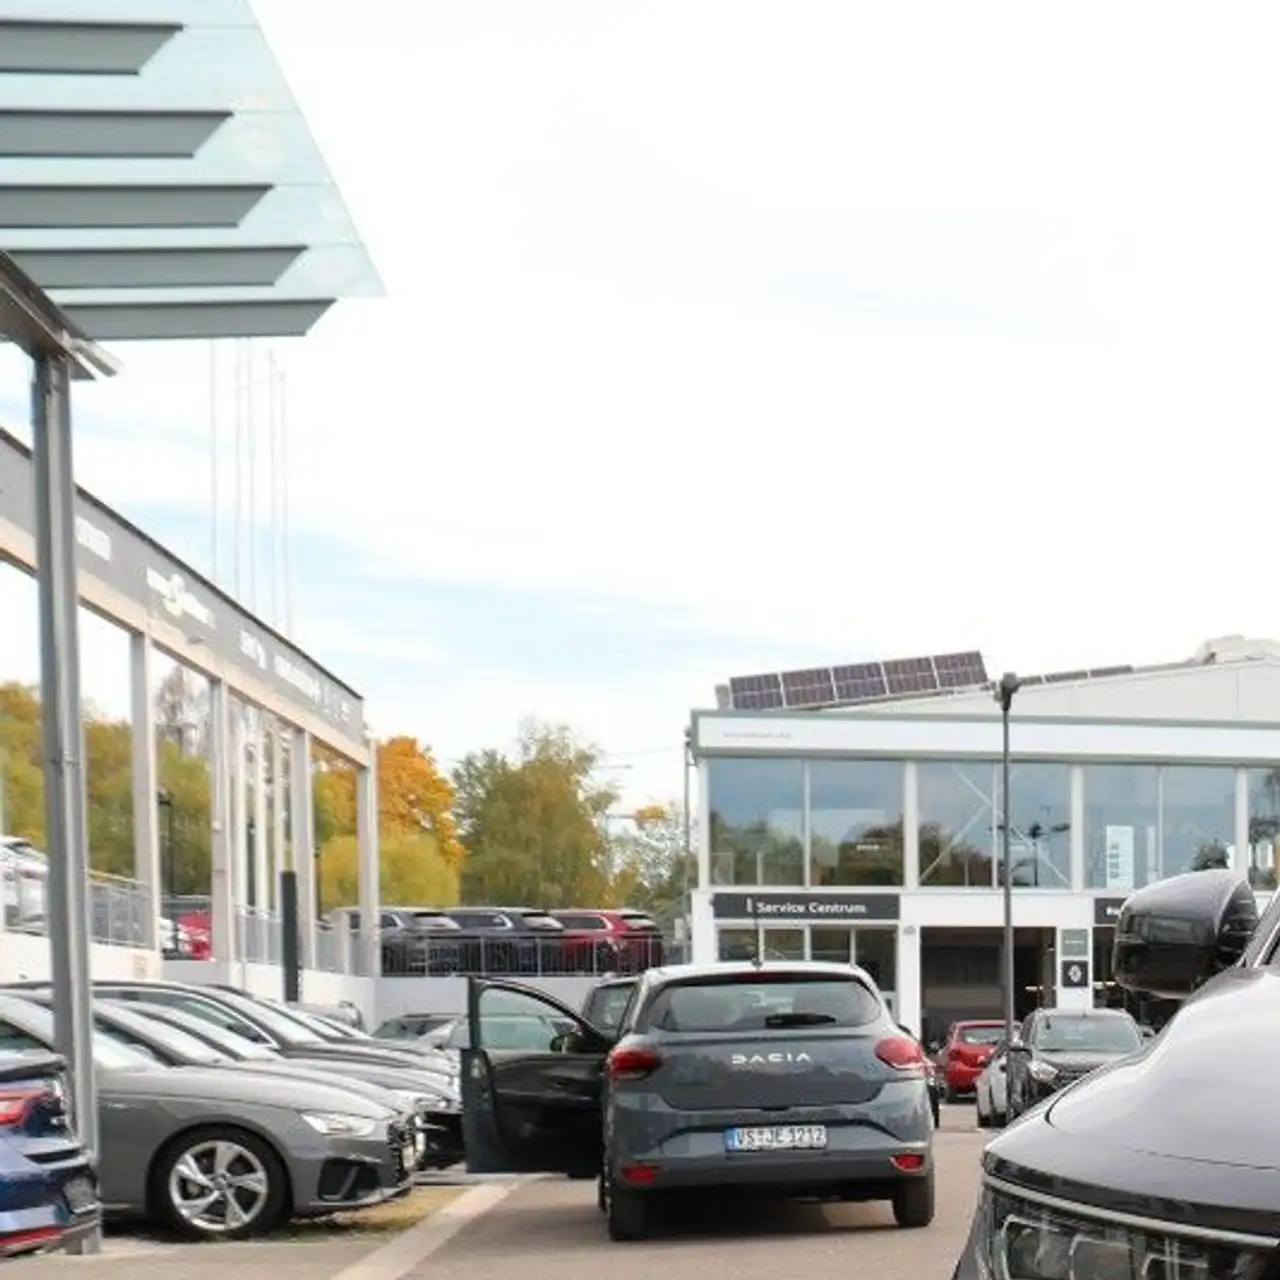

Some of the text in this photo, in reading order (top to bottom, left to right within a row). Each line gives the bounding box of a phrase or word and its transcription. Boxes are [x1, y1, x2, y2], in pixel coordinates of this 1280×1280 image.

[757, 901, 867, 914] Service Centrum
[732, 1052, 812, 1065] DACIA
